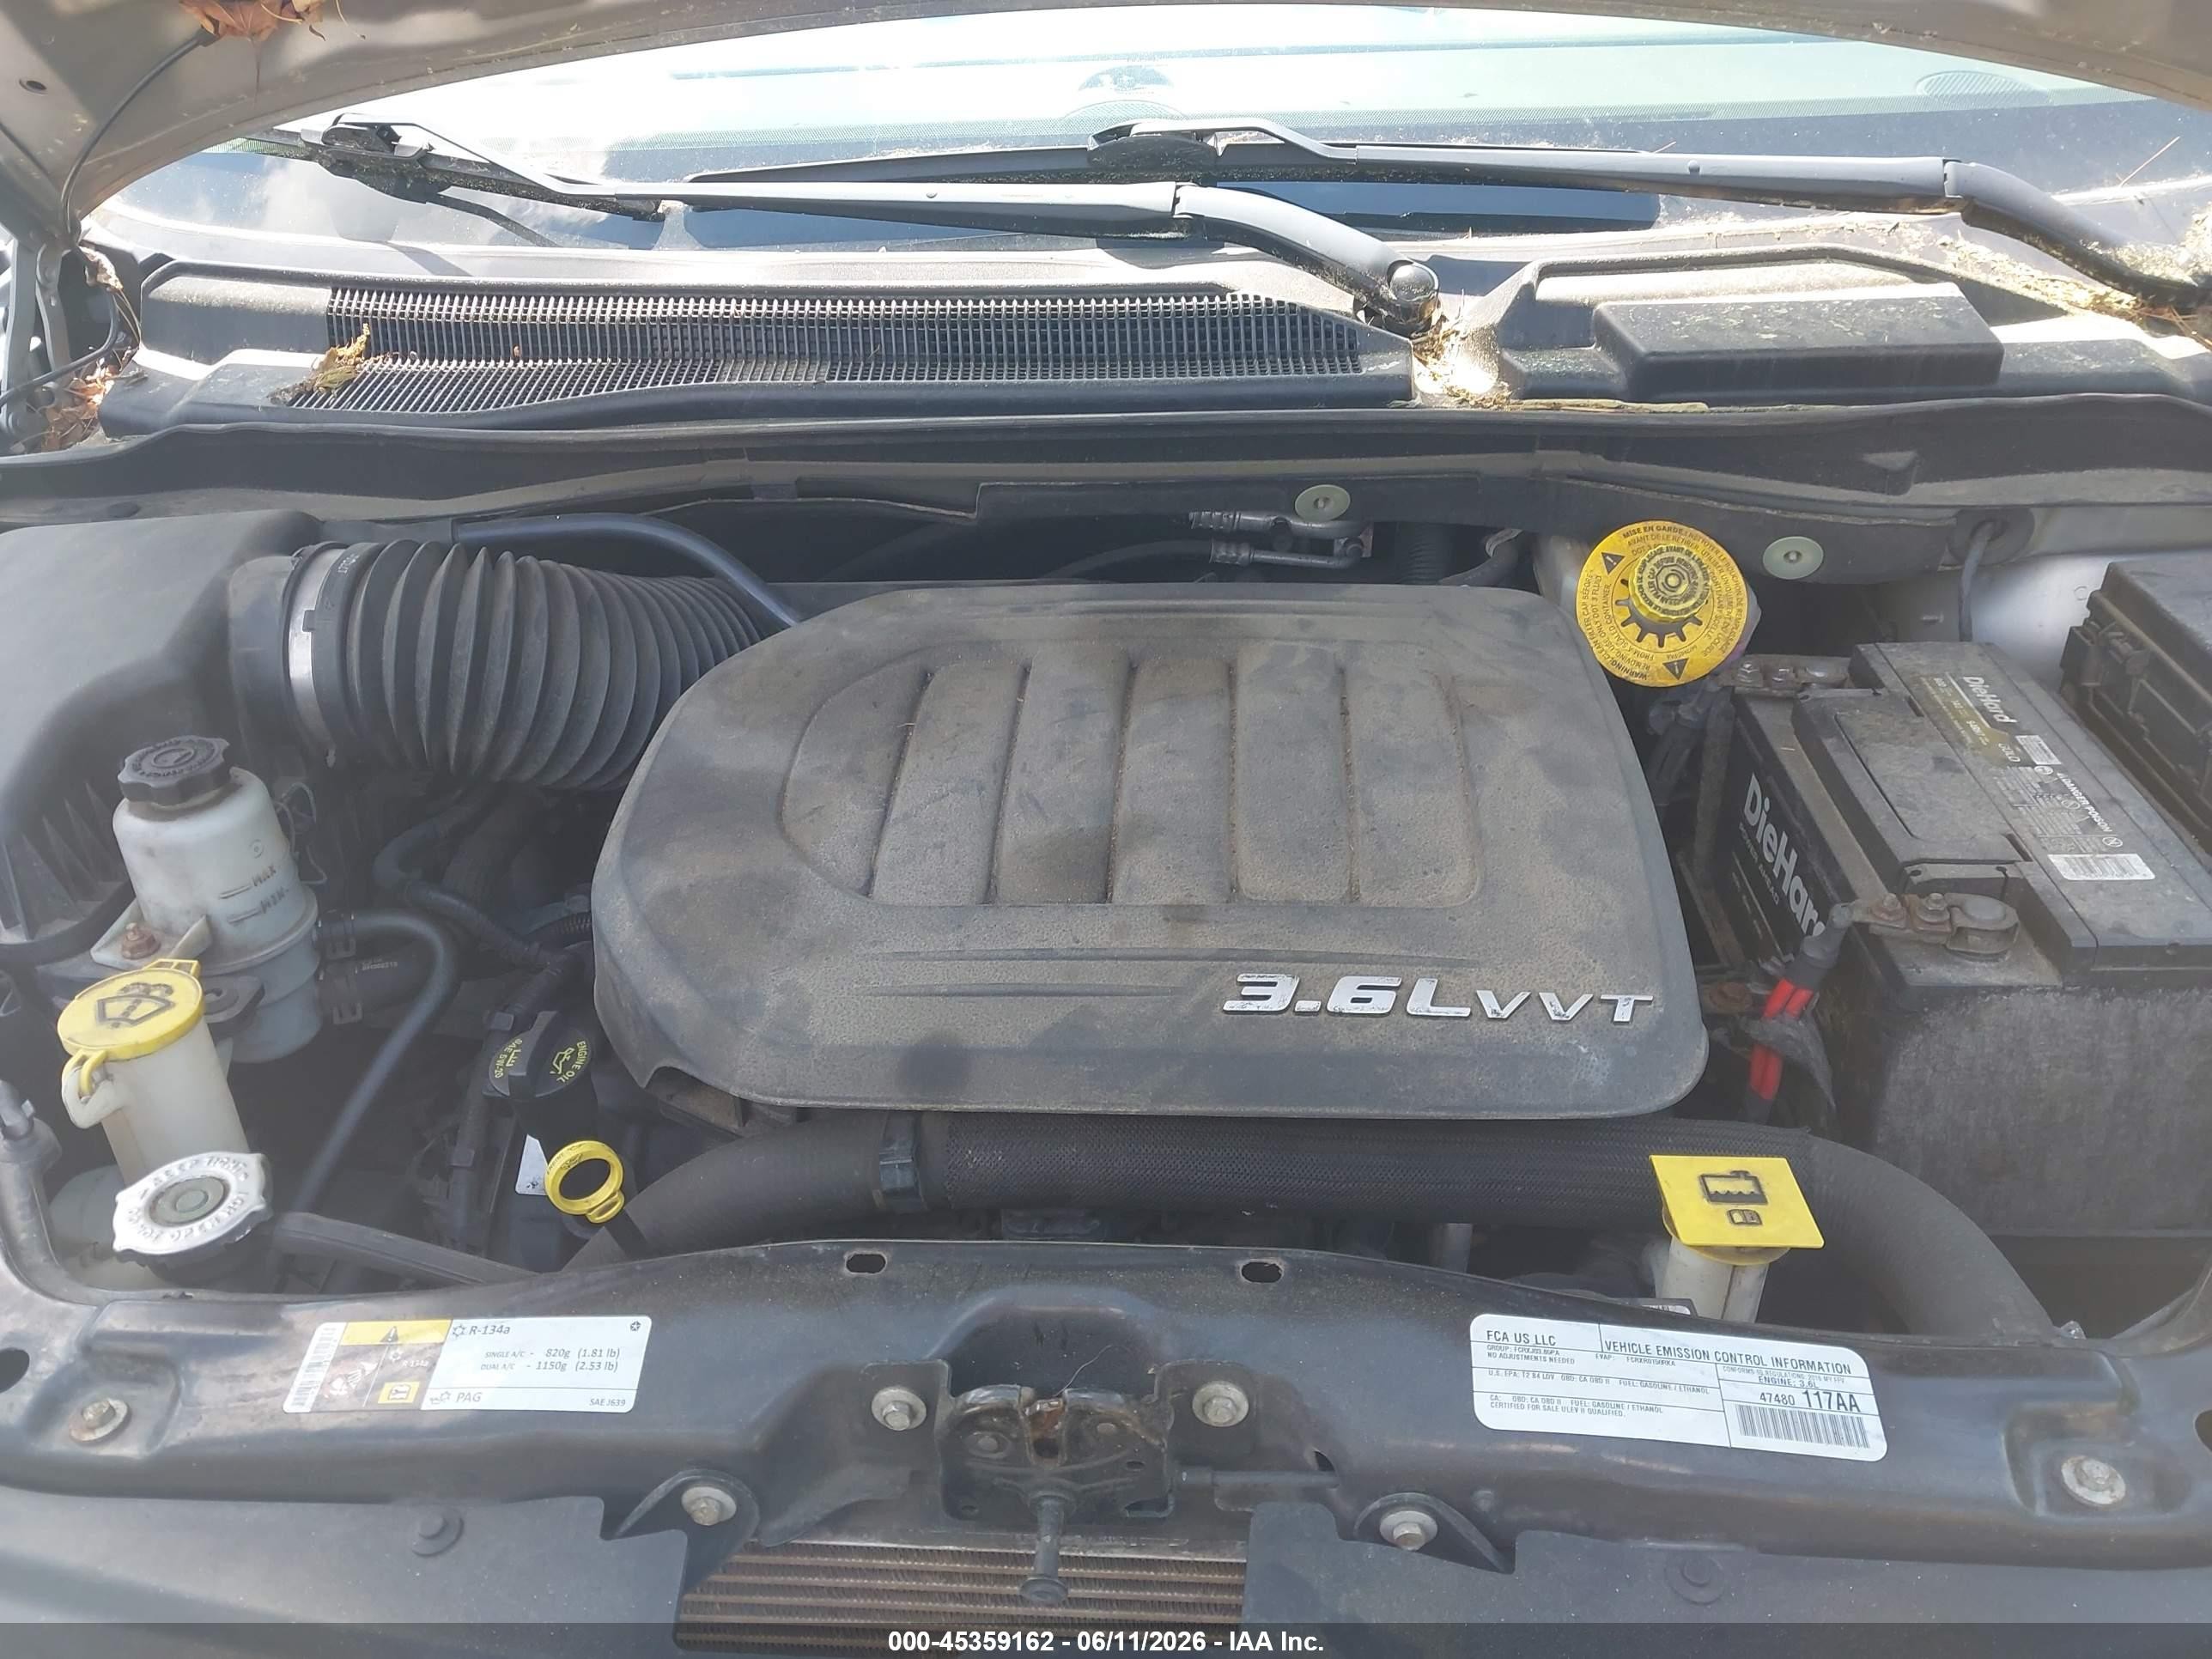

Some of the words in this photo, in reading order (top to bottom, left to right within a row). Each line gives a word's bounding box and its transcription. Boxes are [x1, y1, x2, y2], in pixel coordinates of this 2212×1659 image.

[1621, 526, 1641, 539] MISE
[1642, 524, 1654, 532] EN
[1581, 573, 1594, 599] BEFORE
[1590, 574, 1603, 595] FLUID
[1581, 601, 1589, 617] CAP
[1590, 605, 1600, 618] DOT
[1582, 617, 1597, 641] FILLER
[1593, 619, 1607, 639] ONLY
[1607, 624, 1628, 649] SEALED
[1591, 639, 1611, 661] CLEAN
[1601, 637, 1616, 652] USE
[1632, 648, 1654, 661] FROM
[1963, 676, 2017, 724] DieHard
[252, 864, 276, 887] MAX
[1223, 973, 1472, 1018] 3.6L
[1476, 989, 1653, 1023] VVT
[572, 1040, 587, 1071] ENGINE
[556, 1070, 575, 1083] OIL
[469, 1323, 512, 1336] R-134a
[1486, 1330, 1510, 1342] FCA
[1514, 1333, 1530, 1344] US
[1534, 1334, 1557, 1346] LLC
[545, 1348, 571, 1360] 820g
[577, 1347, 603, 1359] (1.81
[605, 1347, 620, 1359] lb)
[1498, 1352, 1547, 1362] ADJUSTMENTS
[1604, 1340, 1652, 1355] VEHICLE
[1656, 1345, 1711, 1360] EMISSION
[1714, 1350, 1768, 1367] CONTROL
[1771, 1357, 1851, 1375] INFORMATION
[535, 1361, 568, 1372] 1150g
[574, 1361, 601, 1372] (2.53
[604, 1361, 618, 1372] lb)
[1619, 1379, 1638, 1388] FUEL:
[1639, 1381, 1672, 1390] GASOLINE
[1679, 1384, 1711, 1395] ETHANOL
[1759, 1376, 1797, 1387] ENGINE:
[1799, 1380, 1820, 1389] 3.6L
[456, 1391, 483, 1403] PAG
[589, 1398, 605, 1407] SAE
[606, 1399, 626, 1407] J639
[1759, 1392, 1796, 1406] 47480
[1802, 1389, 1862, 1413] 117AA
[1490, 1401, 1525, 1411] CERTIFIED
[1592, 1401, 1625, 1410] GASOLINE
[1632, 1404, 1662, 1413] ETHANOL
